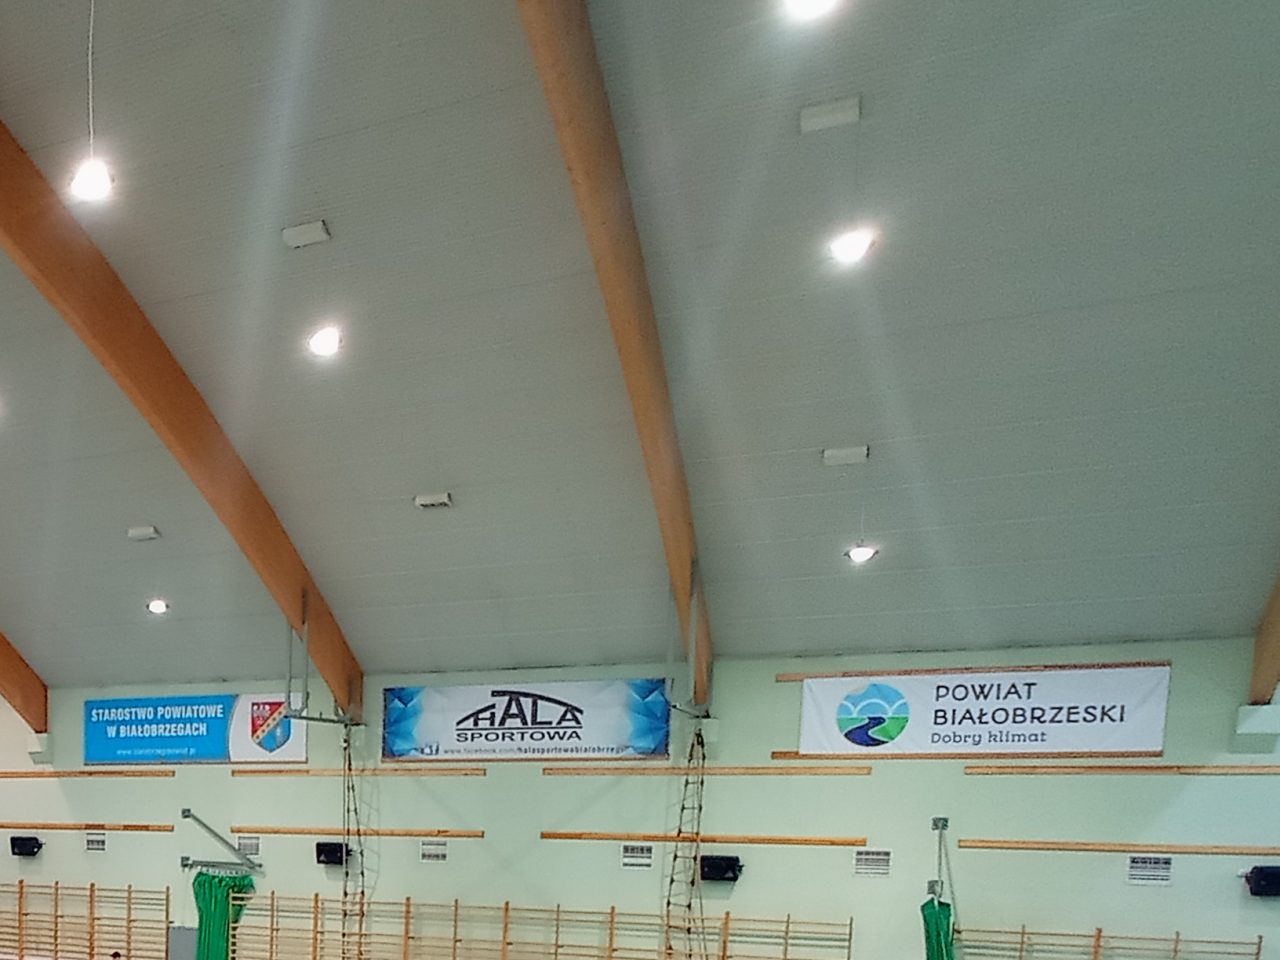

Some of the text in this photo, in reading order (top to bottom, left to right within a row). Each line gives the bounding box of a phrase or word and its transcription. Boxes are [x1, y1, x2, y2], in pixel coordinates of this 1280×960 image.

[935, 683, 1037, 701] POWIAT
[91, 704, 224, 722] STAROSTWO POWIATOWE
[456, 690, 583, 728] HALA
[933, 704, 1125, 726] BIAŁOBRZESKI
[106, 723, 207, 738] W BIAŁOBRZEGACH
[456, 730, 582, 743] SPORTOWA
[931, 731, 1048, 746] Dobry klimat
